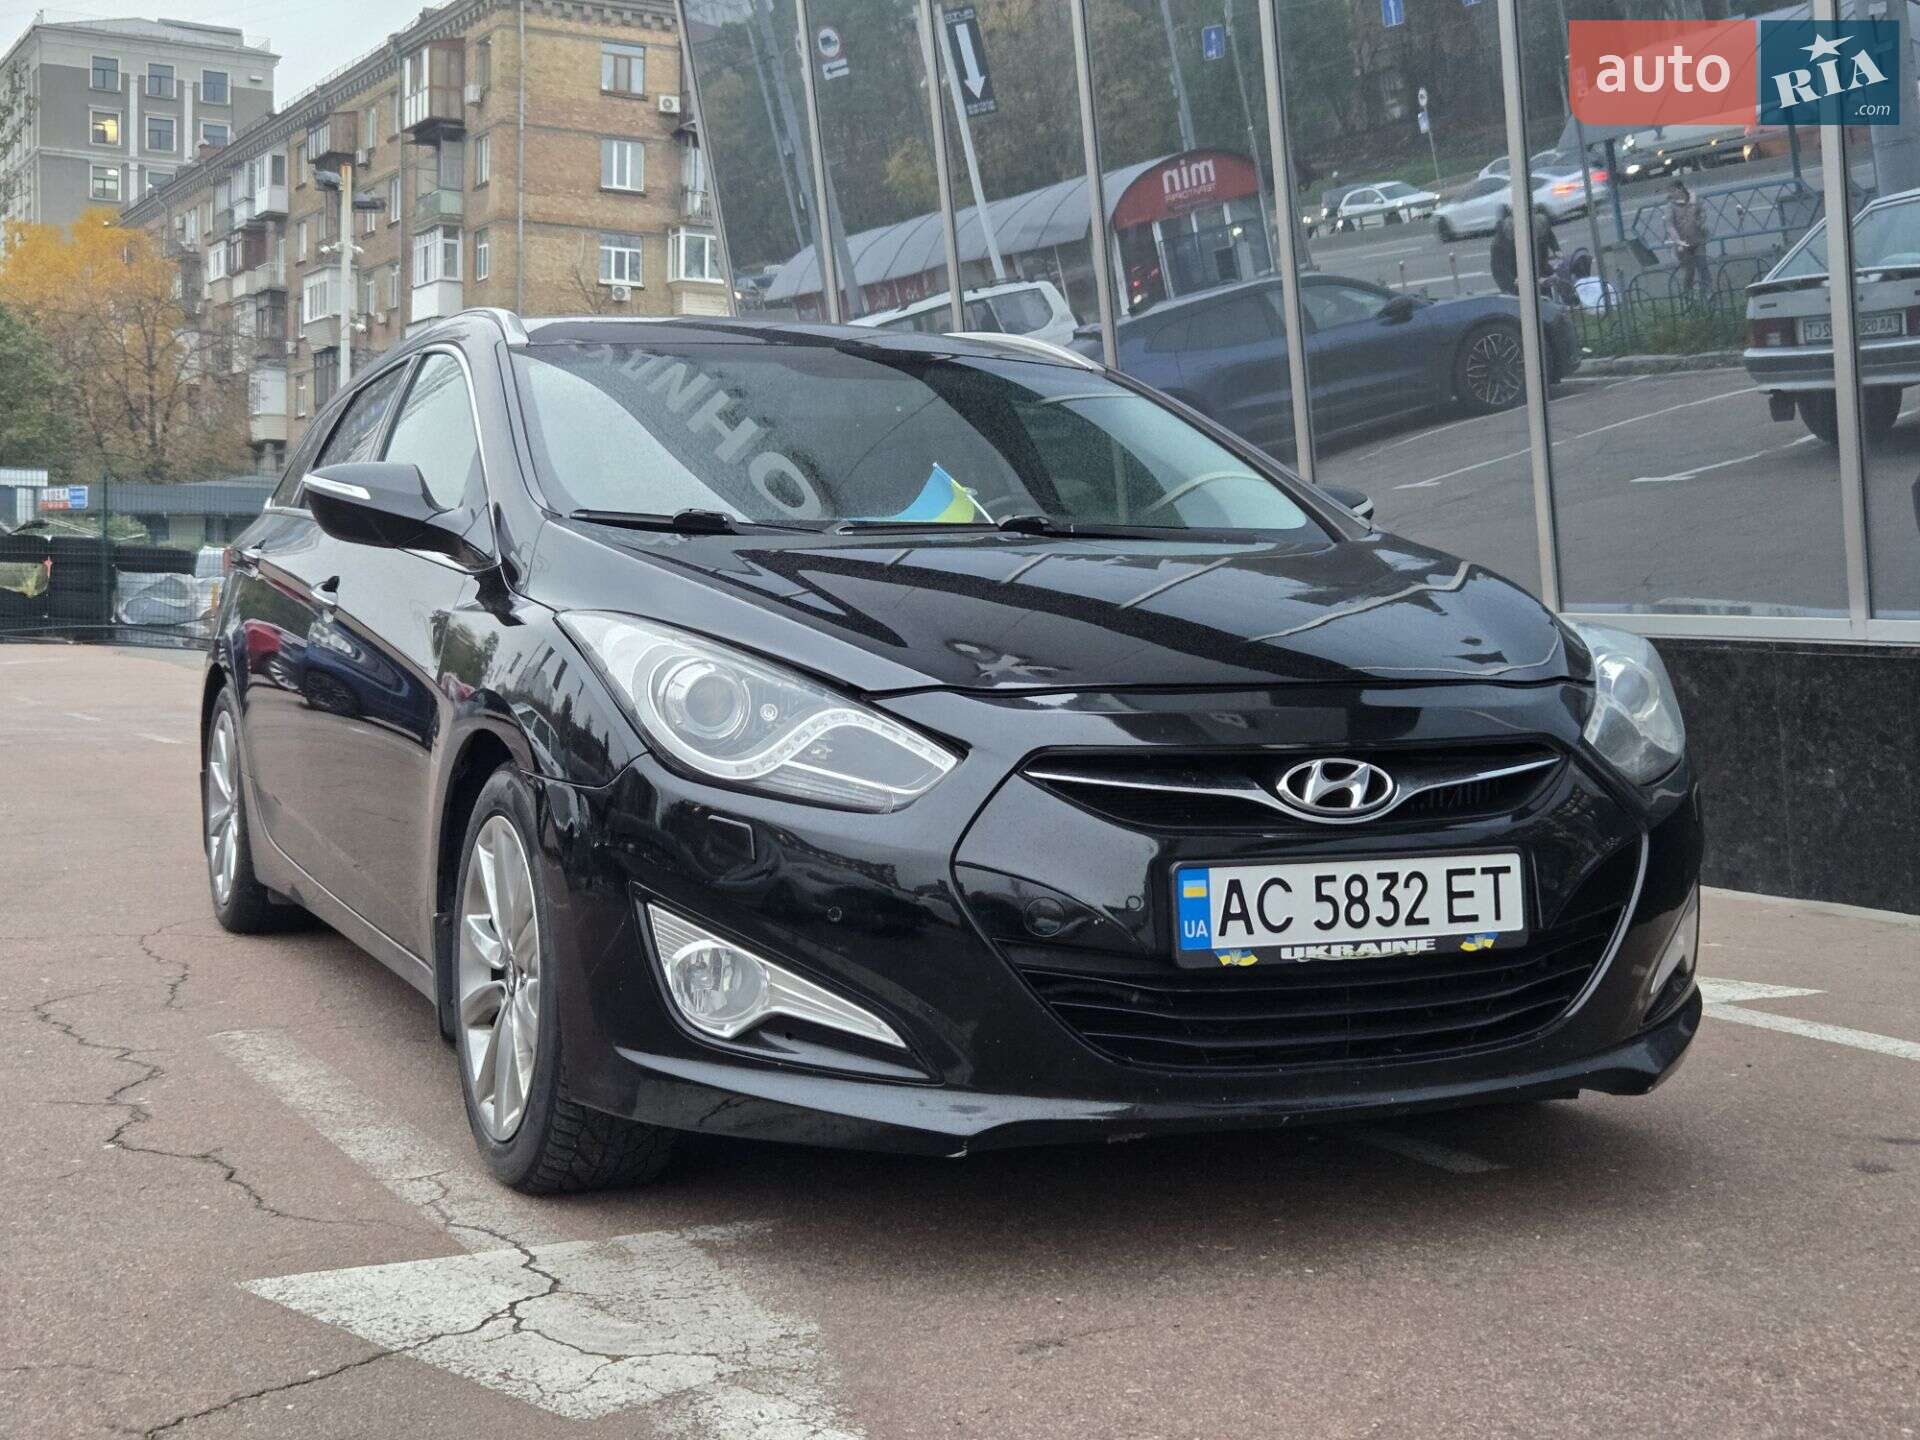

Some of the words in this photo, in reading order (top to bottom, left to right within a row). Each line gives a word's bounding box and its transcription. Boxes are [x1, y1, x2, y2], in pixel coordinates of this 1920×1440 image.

[1184, 920, 1208, 938] UA
[1218, 877, 1294, 937] AC
[1313, 871, 1430, 931] 5832
[1446, 866, 1511, 924] ET
[1280, 938, 1436, 960] UKRAINE
